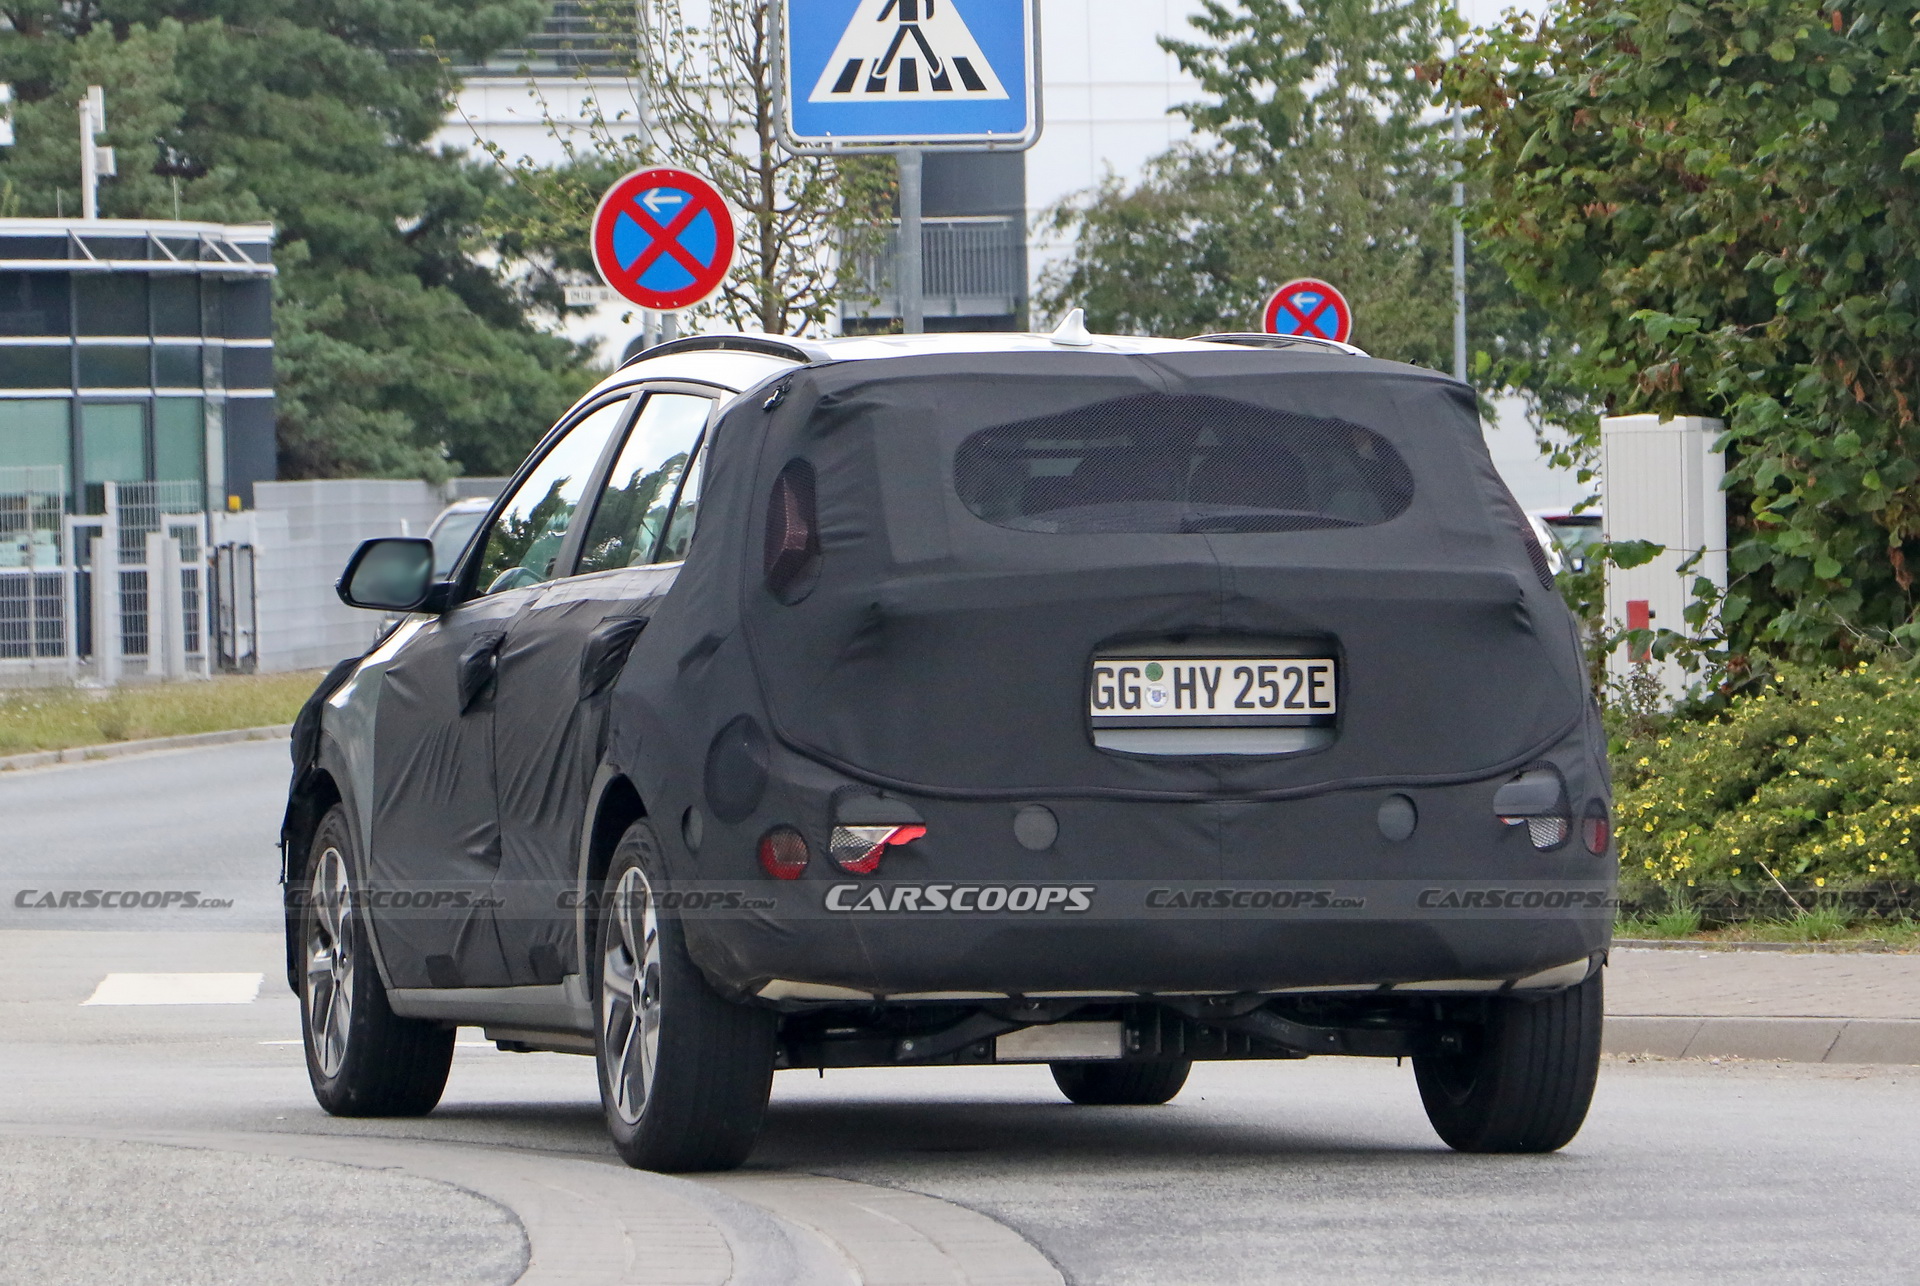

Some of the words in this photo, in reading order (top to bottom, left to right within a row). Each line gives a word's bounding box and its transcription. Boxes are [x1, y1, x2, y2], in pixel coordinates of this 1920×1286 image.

[1092, 667, 1141, 710] GG
[1174, 666, 1222, 709] HY
[1233, 665, 1330, 709] 252E
